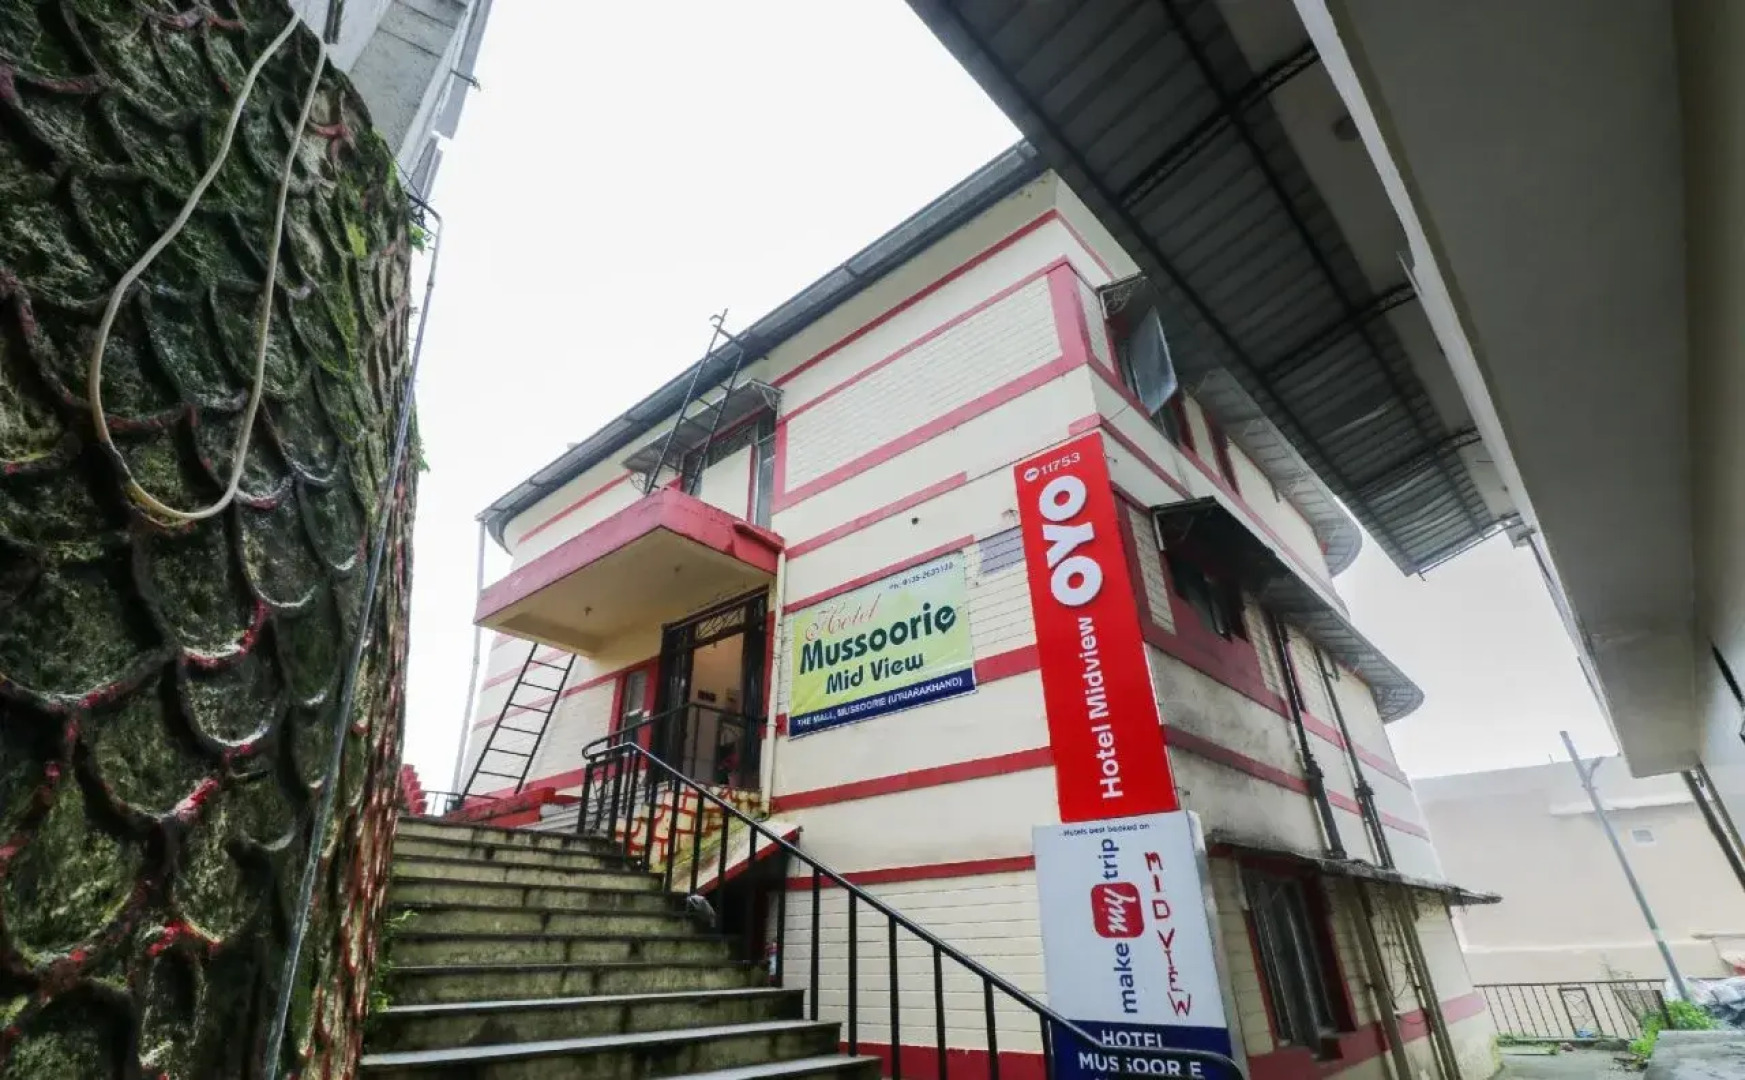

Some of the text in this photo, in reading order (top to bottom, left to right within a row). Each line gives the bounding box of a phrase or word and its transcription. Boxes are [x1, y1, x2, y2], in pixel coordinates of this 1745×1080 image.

[1041, 452, 1081, 475] 11753
[1038, 475, 1103, 607] OYO
[800, 602, 956, 675] Mussoorie
[805, 593, 882, 641] Hotel
[826, 653, 924, 695] Mid View
[1078, 617, 1124, 799] Hotel Midview
[1098, 838, 1138, 1014] make my trip
